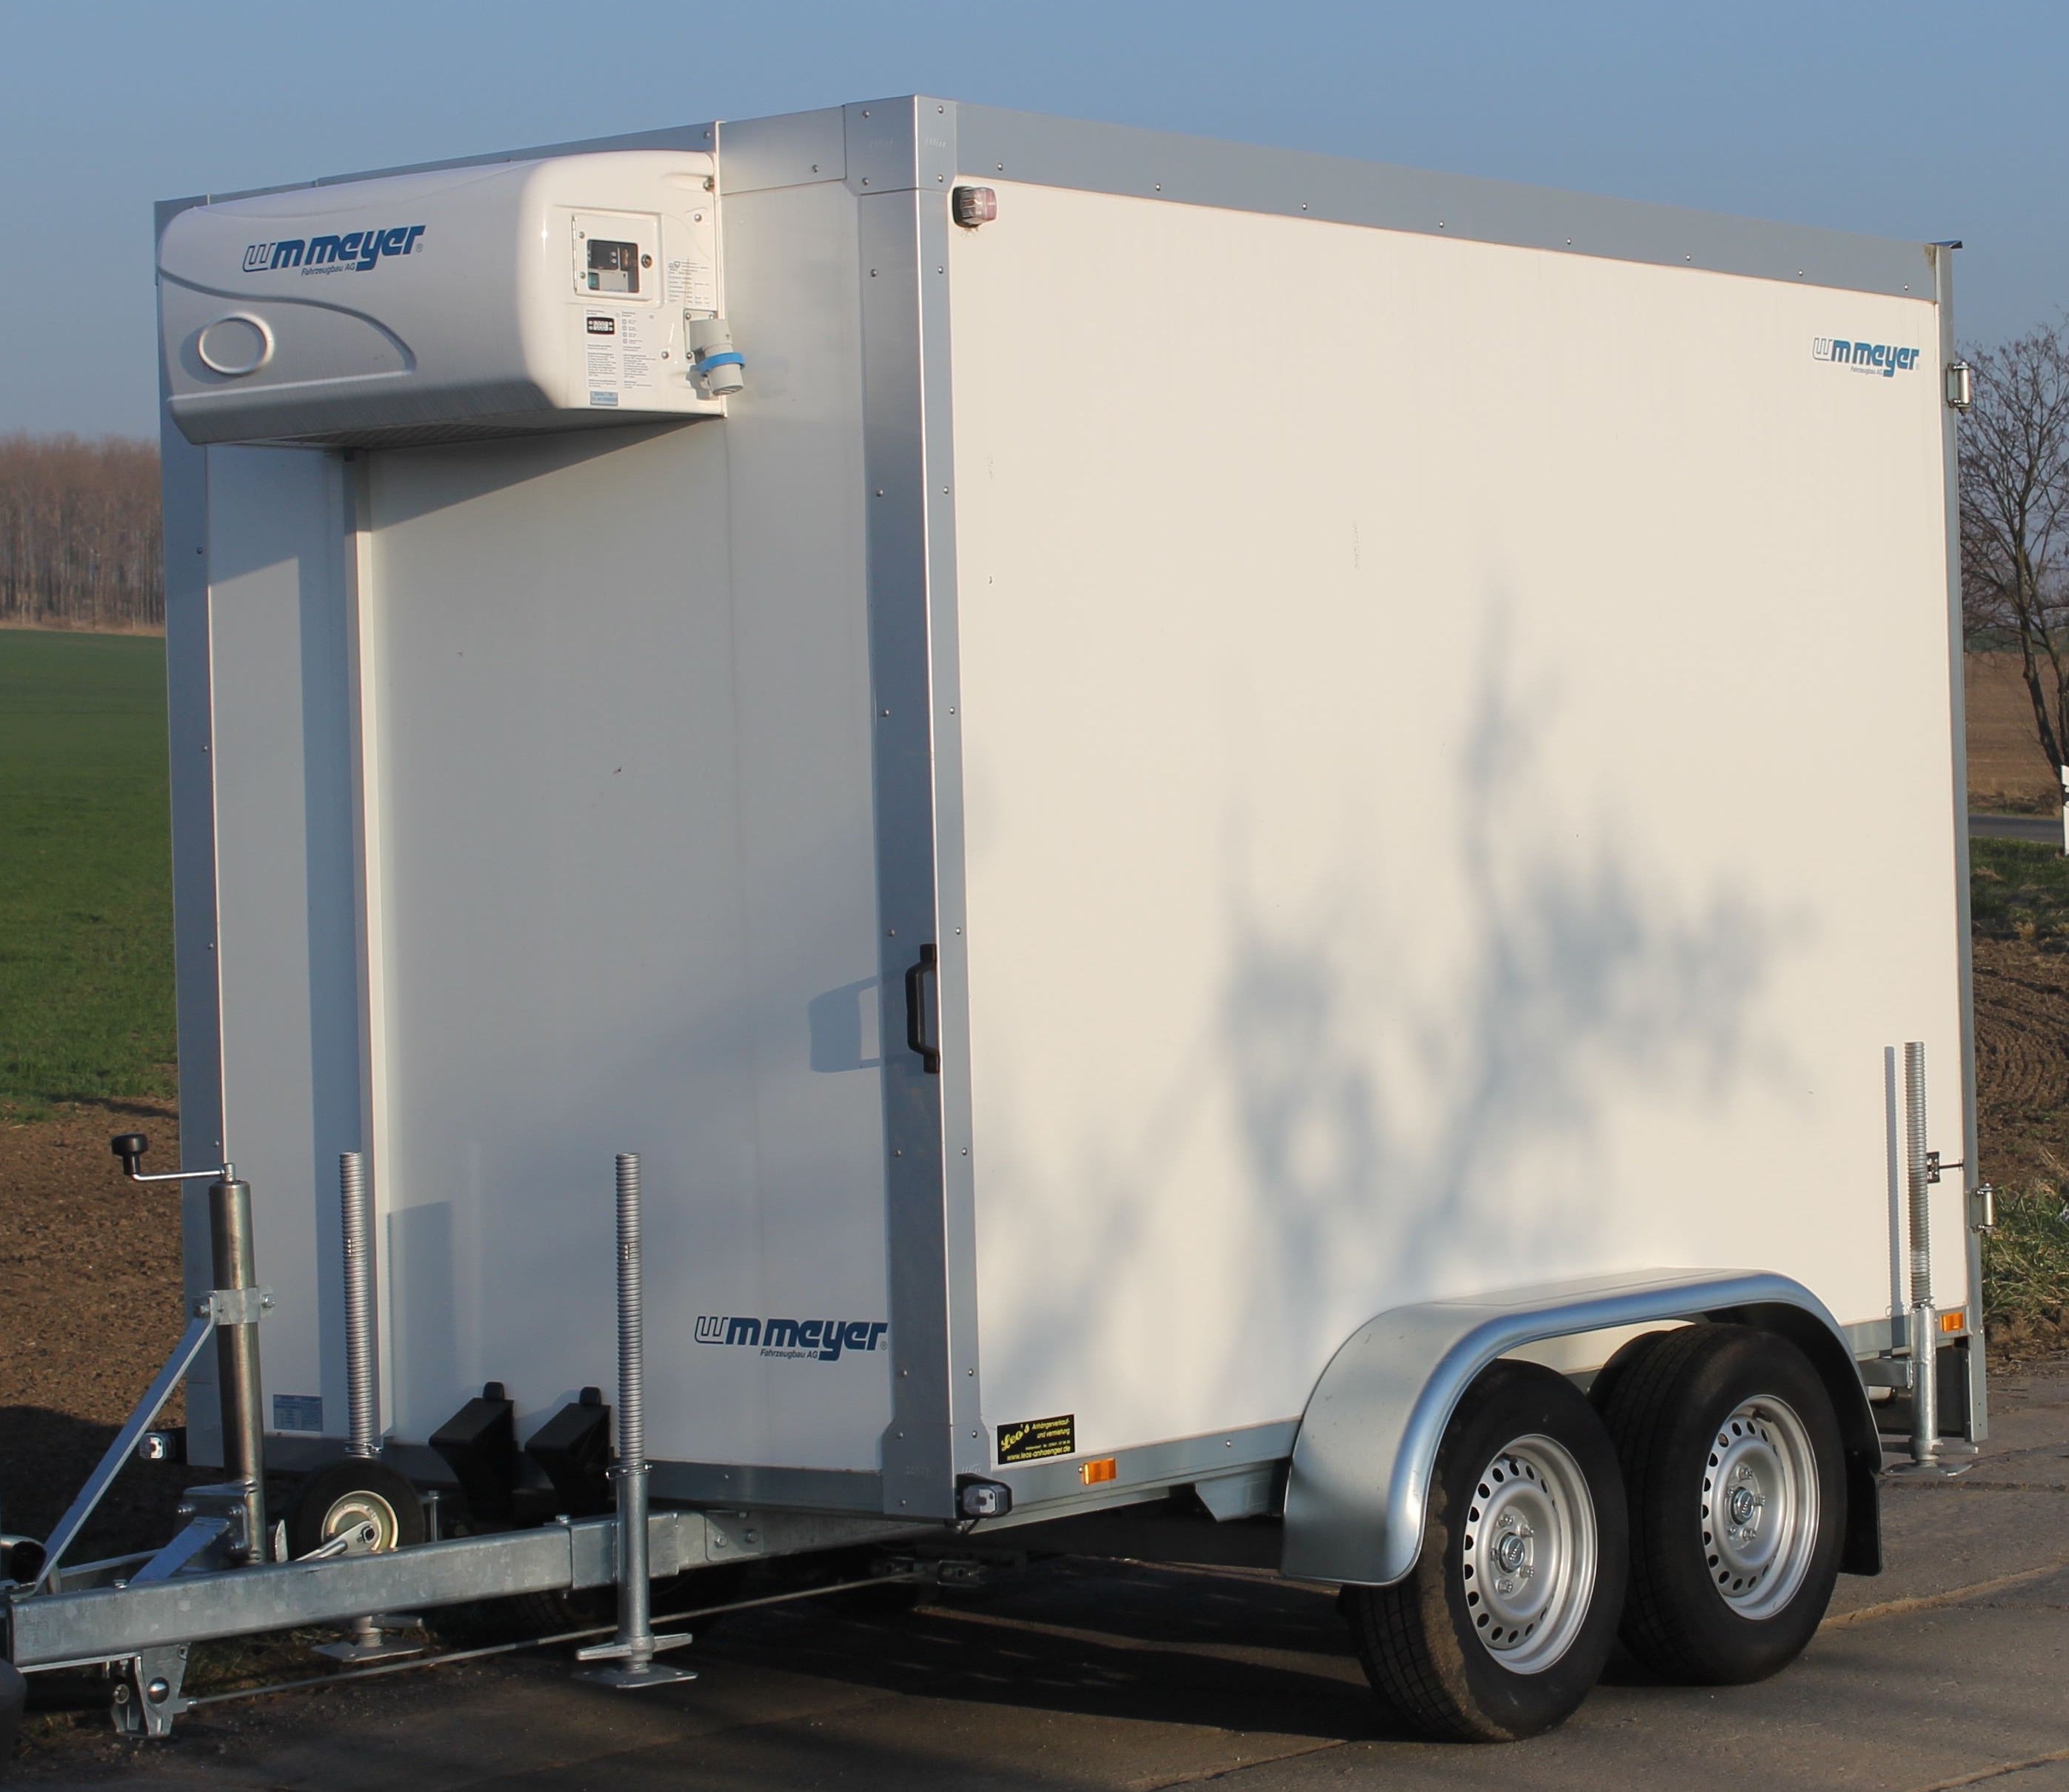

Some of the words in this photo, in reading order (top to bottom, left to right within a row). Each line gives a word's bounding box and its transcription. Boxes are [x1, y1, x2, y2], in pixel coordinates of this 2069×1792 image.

[301, 266, 344, 276] Fahrzeugbau
[344, 263, 355, 272] AG
[761, 1348, 806, 1359] Fahrzeugbau
[806, 1351, 818, 1359] AG
[1000, 1423, 1030, 1451] Leo's
